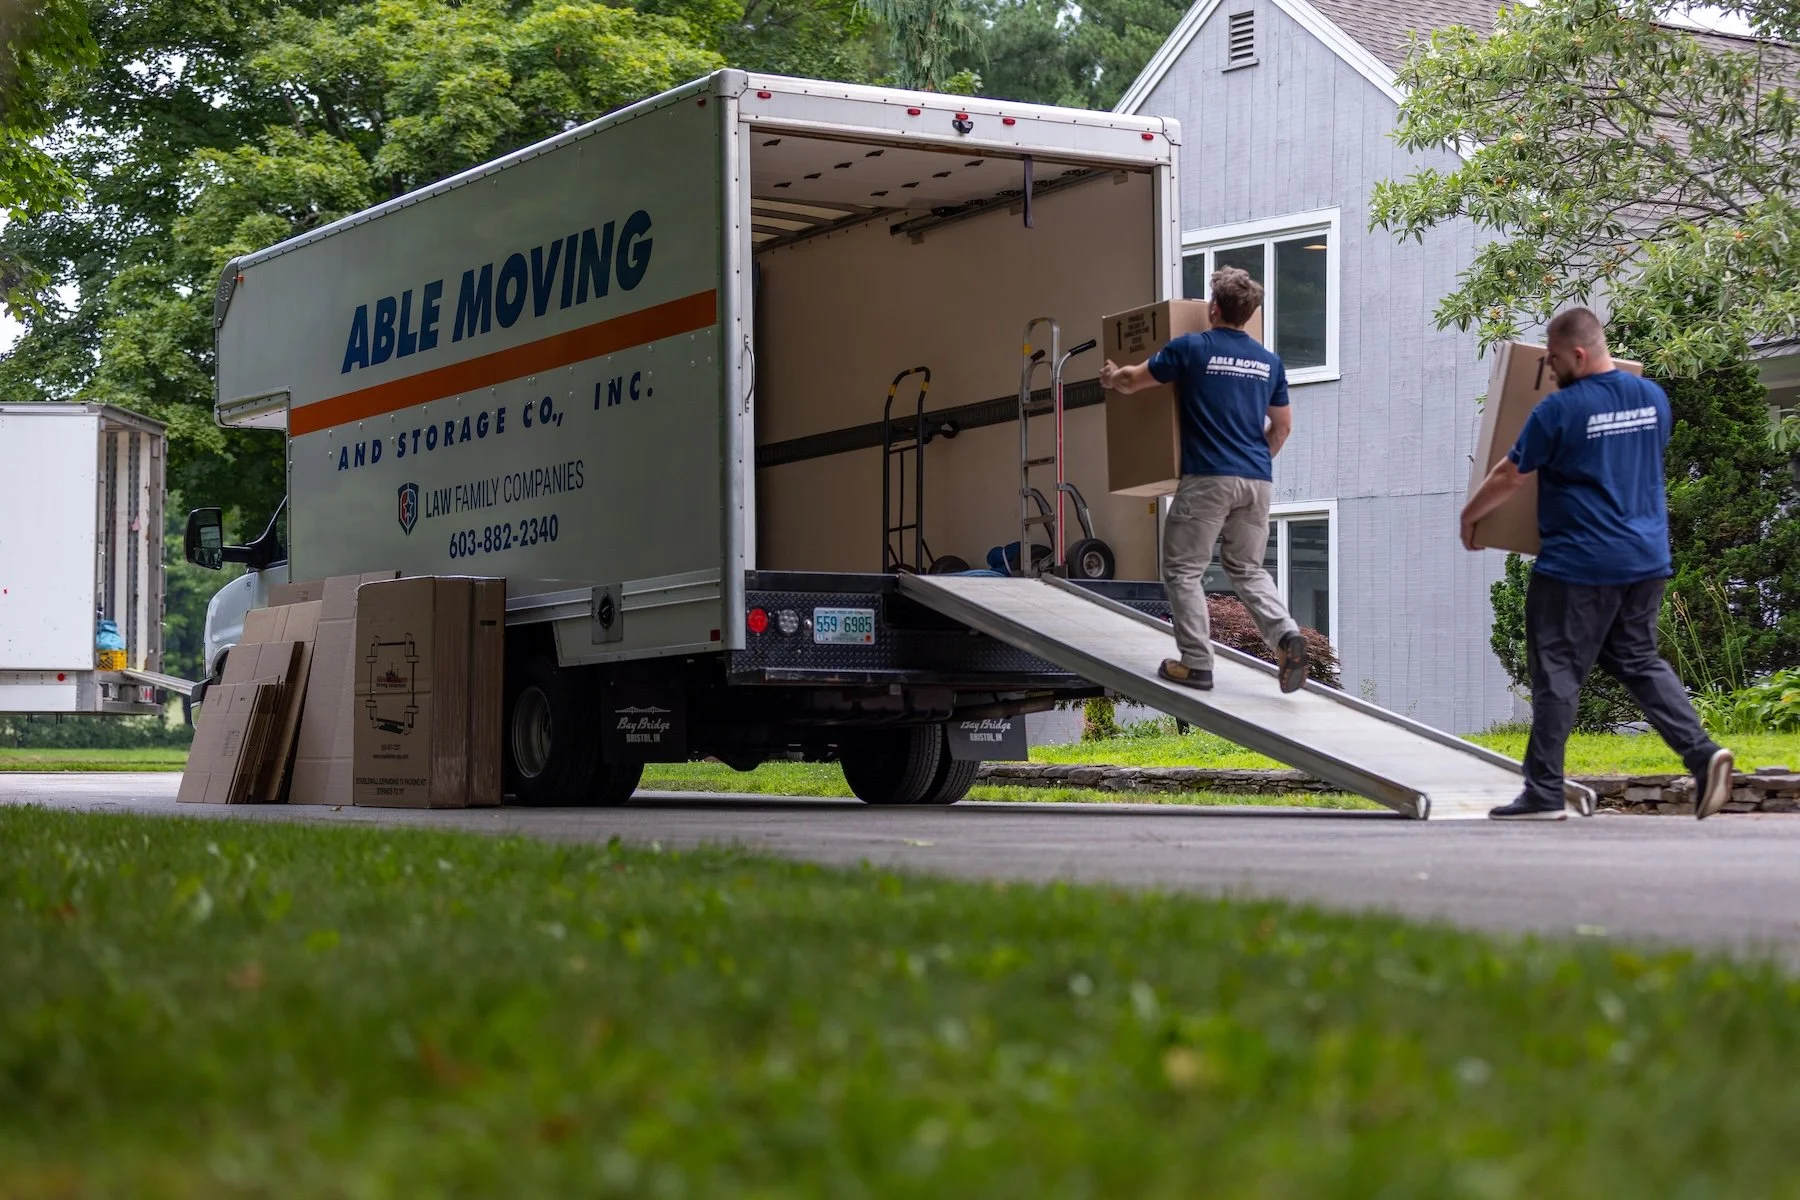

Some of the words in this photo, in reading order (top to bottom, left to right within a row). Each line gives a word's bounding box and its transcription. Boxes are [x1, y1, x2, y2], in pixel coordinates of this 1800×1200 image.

[341, 279, 443, 374] ABLE
[452, 209, 653, 343] MOVING
[1208, 355, 1234, 366] ABLE
[1235, 358, 1271, 372] MOVING
[338, 439, 382, 471] AND
[397, 407, 506, 458] STORAGE
[523, 396, 563, 428] CO.,
[594, 371, 653, 410] INC.
[425, 489, 451, 518] LAW
[455, 477, 499, 513] FAMILY
[504, 460, 585, 503] COMPANIES
[449, 514, 559, 559] 603-882-2340
[816, 615, 837, 632] 559
[844, 616, 872, 633] 6985
[617, 716, 637, 733] Bay
[637, 717, 670, 733] Bridge
[980, 718, 1011, 733] Bridge
